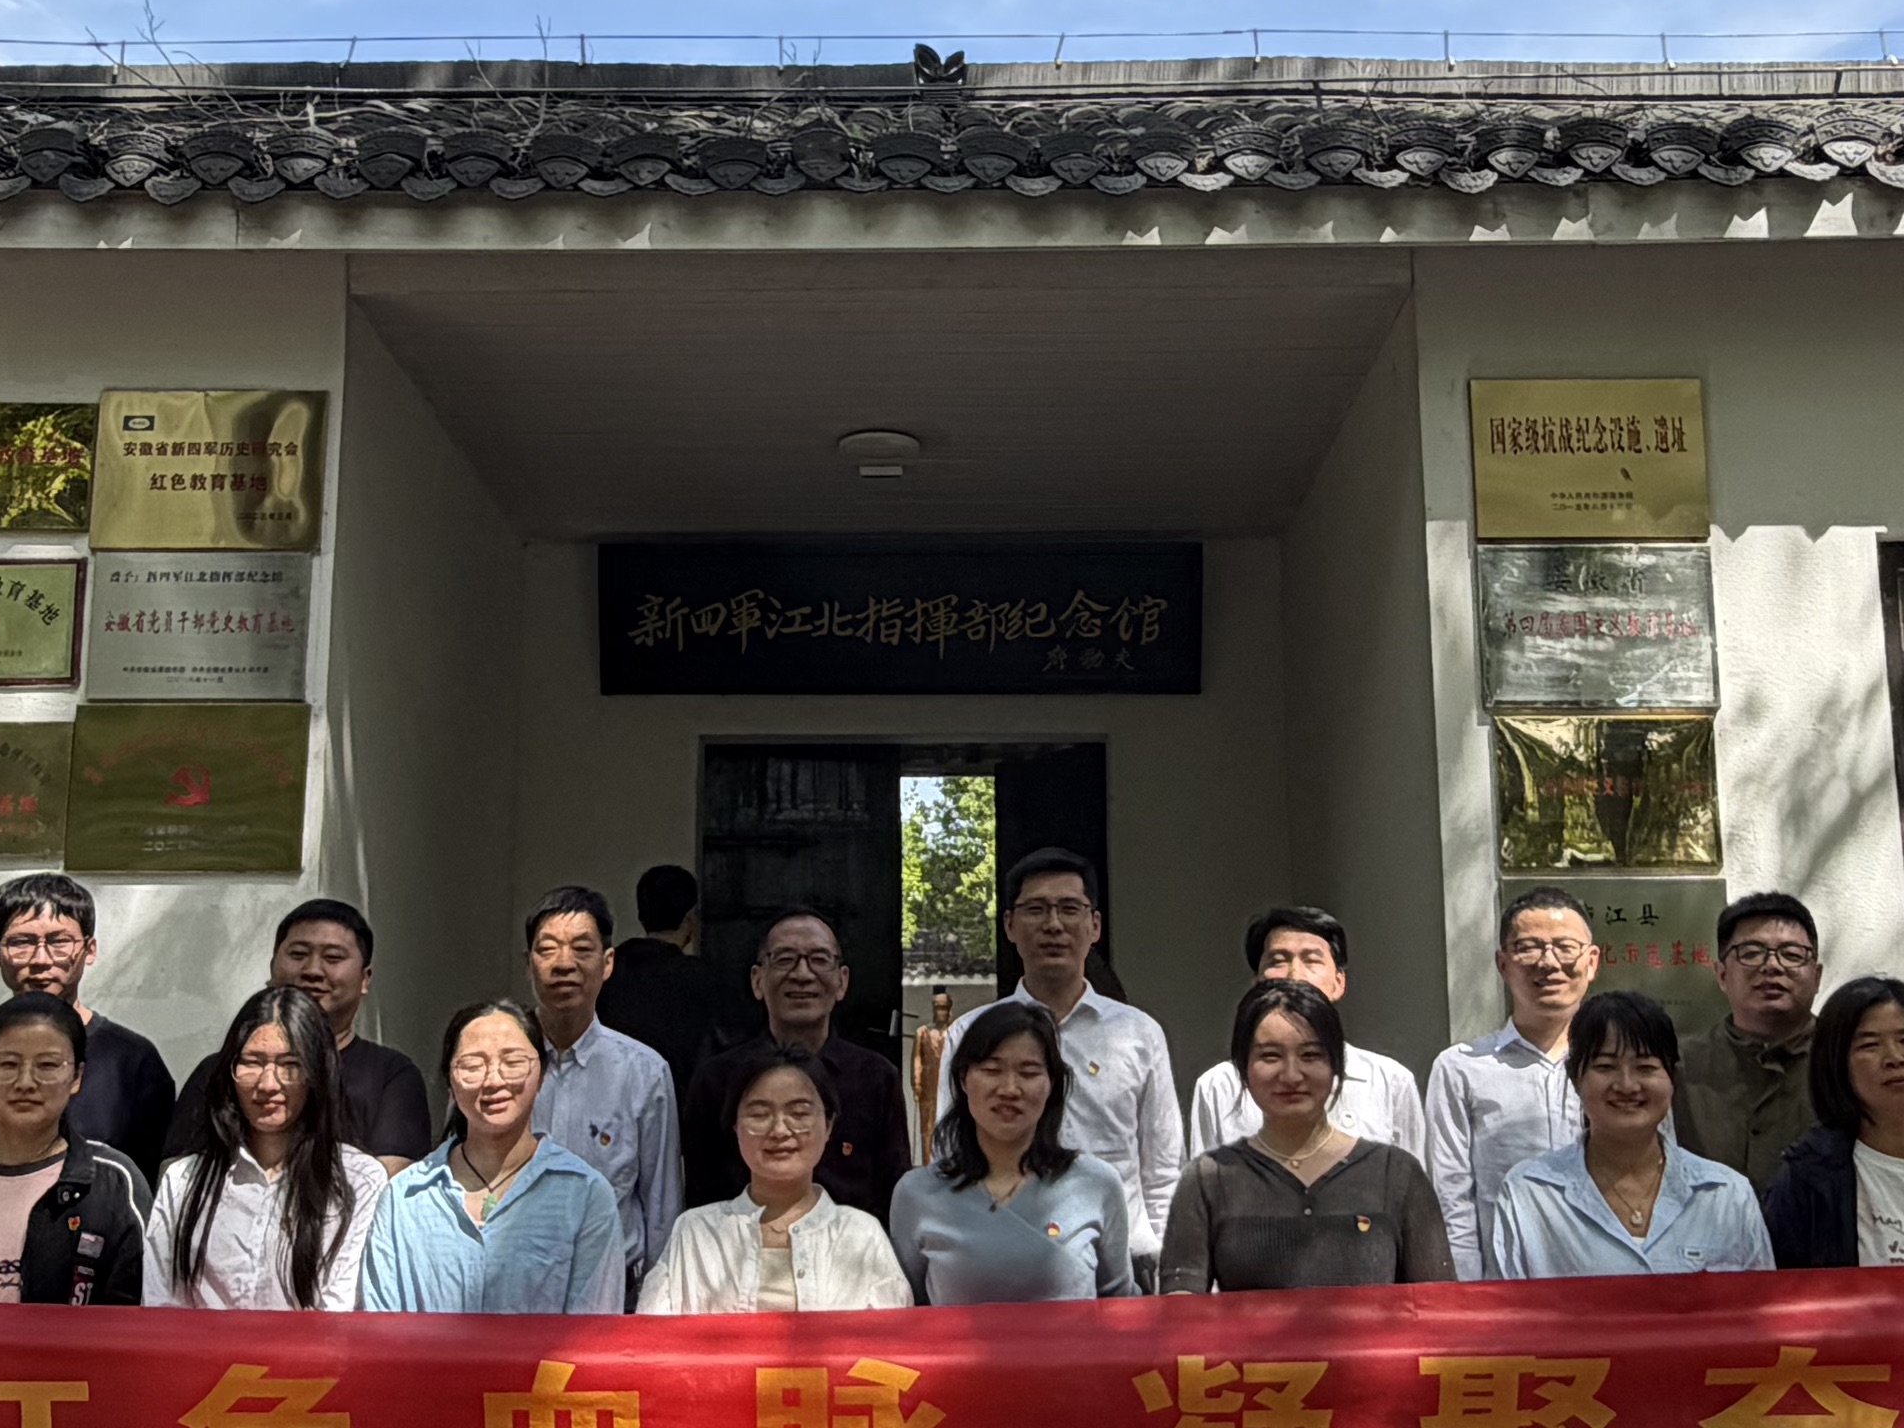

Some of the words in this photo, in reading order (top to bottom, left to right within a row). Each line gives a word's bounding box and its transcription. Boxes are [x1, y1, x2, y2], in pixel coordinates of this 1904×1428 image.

[1489, 415, 1688, 455] 国家级抗战纪念设施、遗址
[122, 441, 299, 457] 安徽省新四军历史研究会
[149, 473, 268, 492] 红色教育基地
[104, 609, 295, 635] 安徽省党员干部党史教育基地
